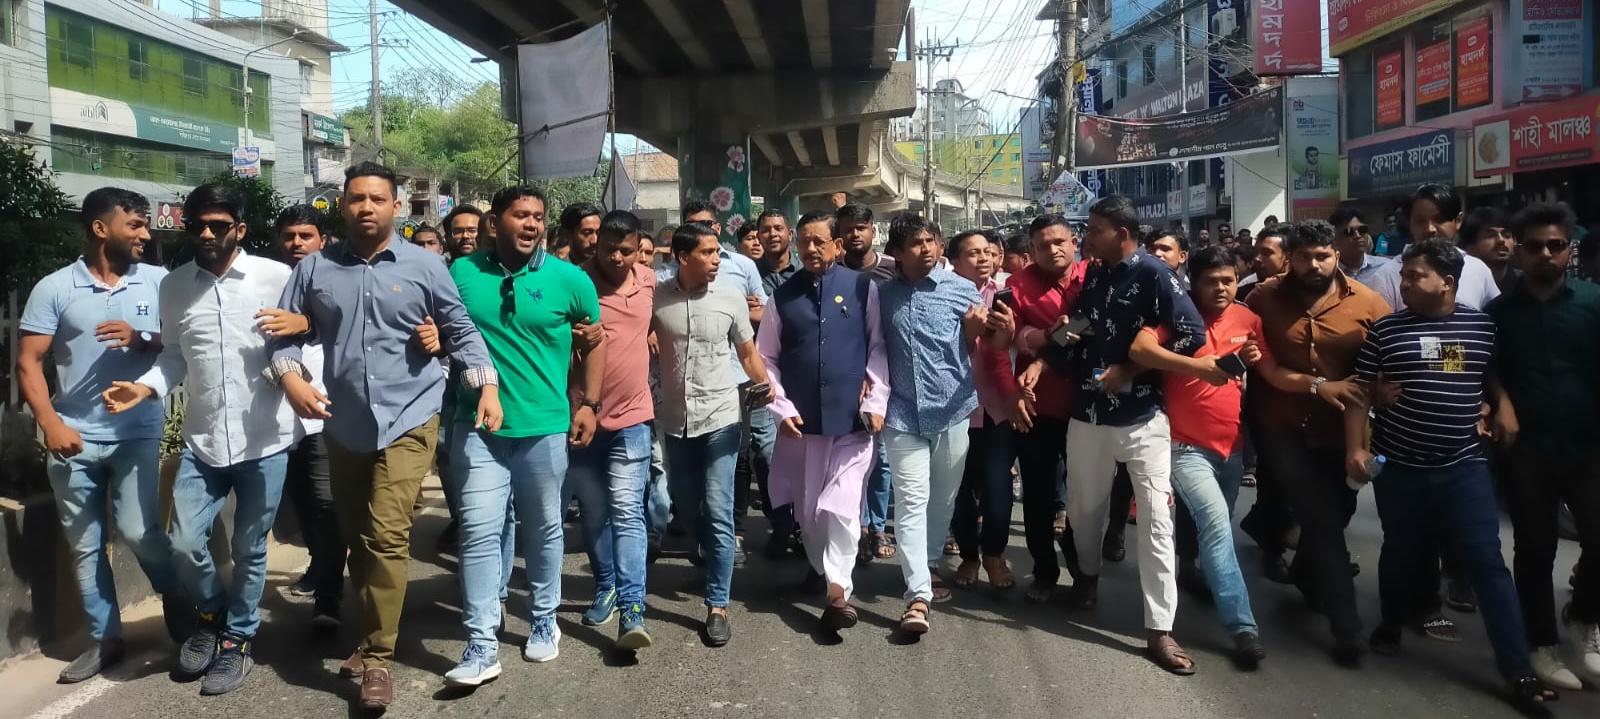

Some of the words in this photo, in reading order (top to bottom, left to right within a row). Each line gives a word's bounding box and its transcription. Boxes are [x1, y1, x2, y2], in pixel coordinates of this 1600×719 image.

[1151, 93, 1178, 116] WALTON
[1179, 80, 1205, 105] AZA
[1512, 115, 1543, 150] শাহী
[1547, 115, 1591, 144] মালঞ্চ
[1370, 150, 1404, 175] ফেমাস
[1407, 134, 1451, 168] ফার্মেসী
[1146, 202, 1166, 219] PLAZA
[136, 304, 150, 316] H
